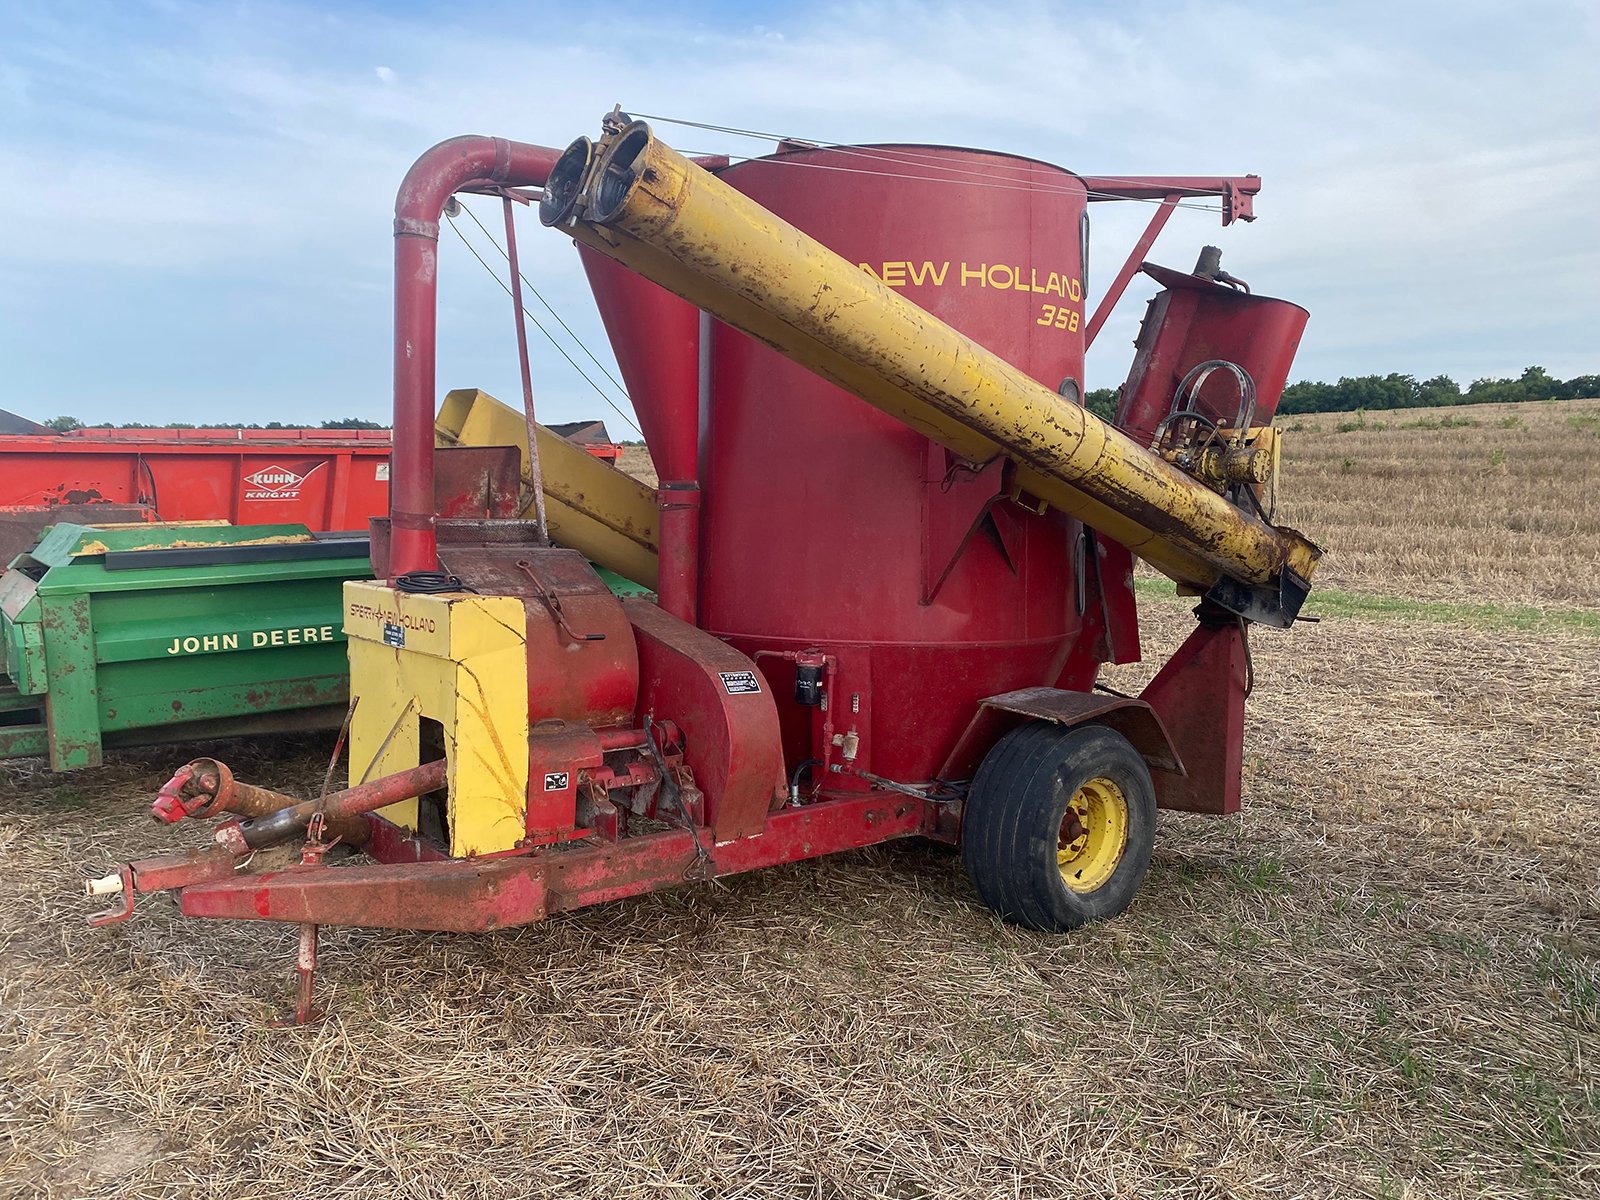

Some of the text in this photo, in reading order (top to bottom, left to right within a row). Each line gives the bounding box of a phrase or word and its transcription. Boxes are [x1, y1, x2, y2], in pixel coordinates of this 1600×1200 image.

[960, 262, 1081, 303] HOLLAND
[1036, 304, 1081, 333] 358
[253, 474, 295, 484] KUHN
[167, 625, 334, 655] JOHN DEERE
